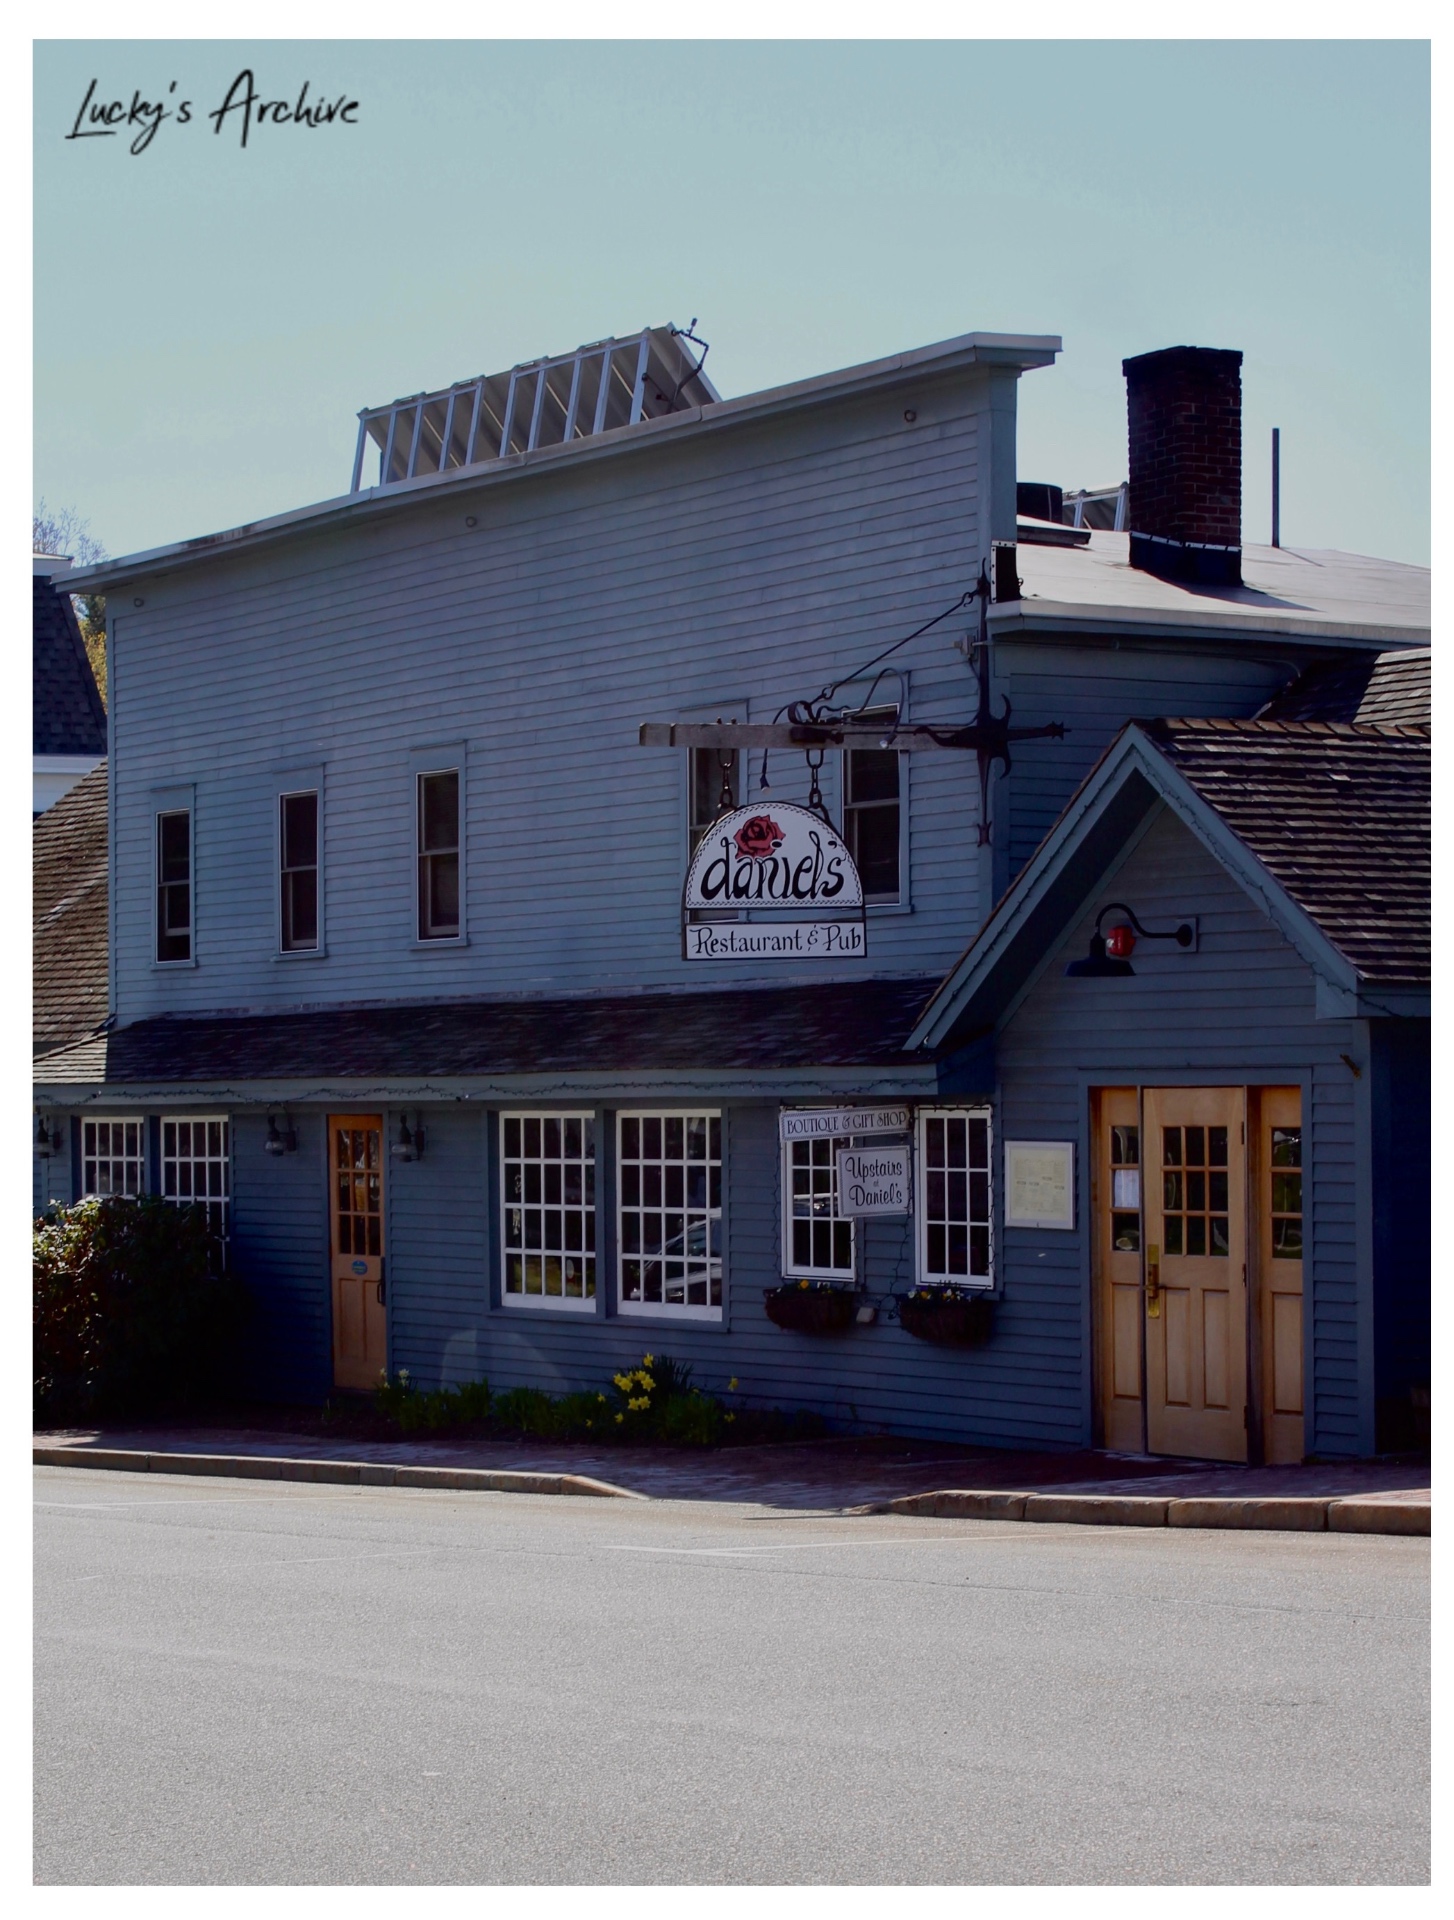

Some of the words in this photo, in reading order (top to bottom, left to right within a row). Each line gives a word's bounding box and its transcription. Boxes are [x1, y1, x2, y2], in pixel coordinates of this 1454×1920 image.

[700, 831, 848, 900] daniel's
[689, 926, 803, 957] Restaurant
[807, 924, 819, 953] &
[820, 924, 861, 952] Pub
[787, 1115, 839, 1135] BOUTIQUE
[841, 1115, 851, 1130] &
[852, 1112, 875, 1129] GIFT
[876, 1110, 907, 1128] SHOP
[845, 1156, 903, 1183] Upstairs
[848, 1183, 903, 1207] Daniel's
